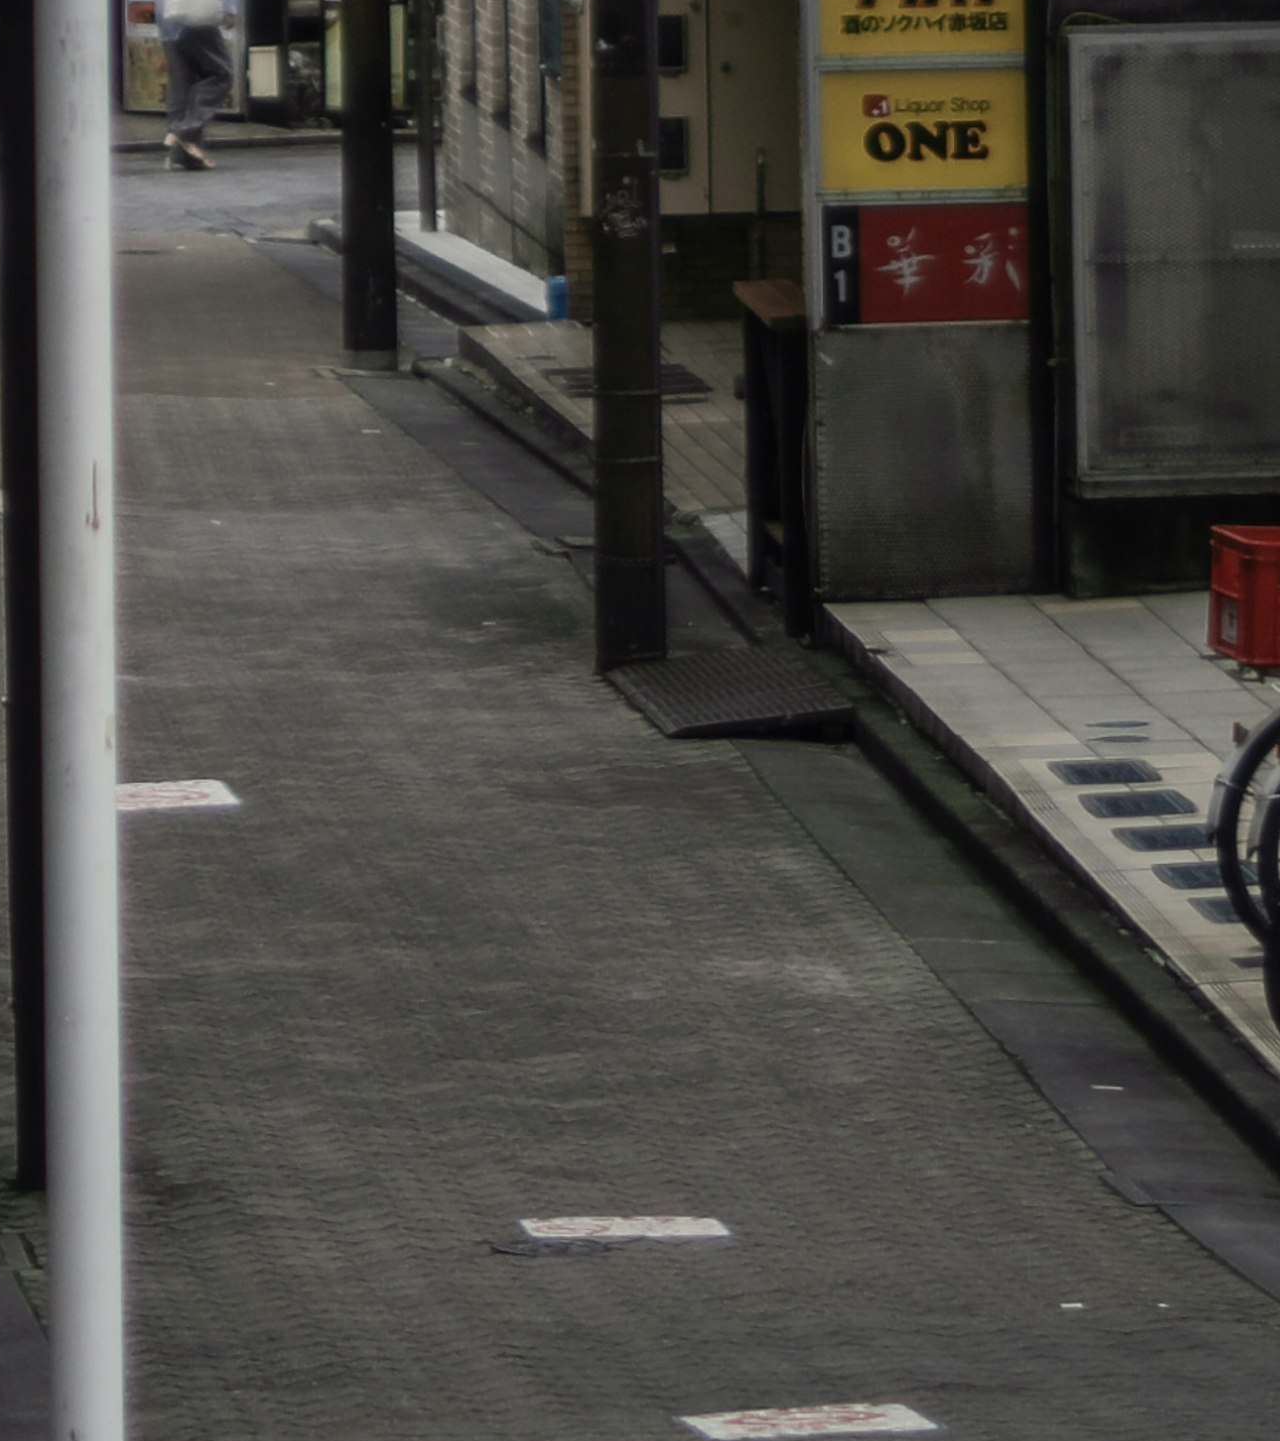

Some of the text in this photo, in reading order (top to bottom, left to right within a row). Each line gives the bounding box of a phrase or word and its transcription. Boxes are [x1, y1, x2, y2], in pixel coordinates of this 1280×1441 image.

[894, 98, 945, 116] Liquor
[950, 97, 990, 115] Shop
[863, 119, 990, 162] ONE
